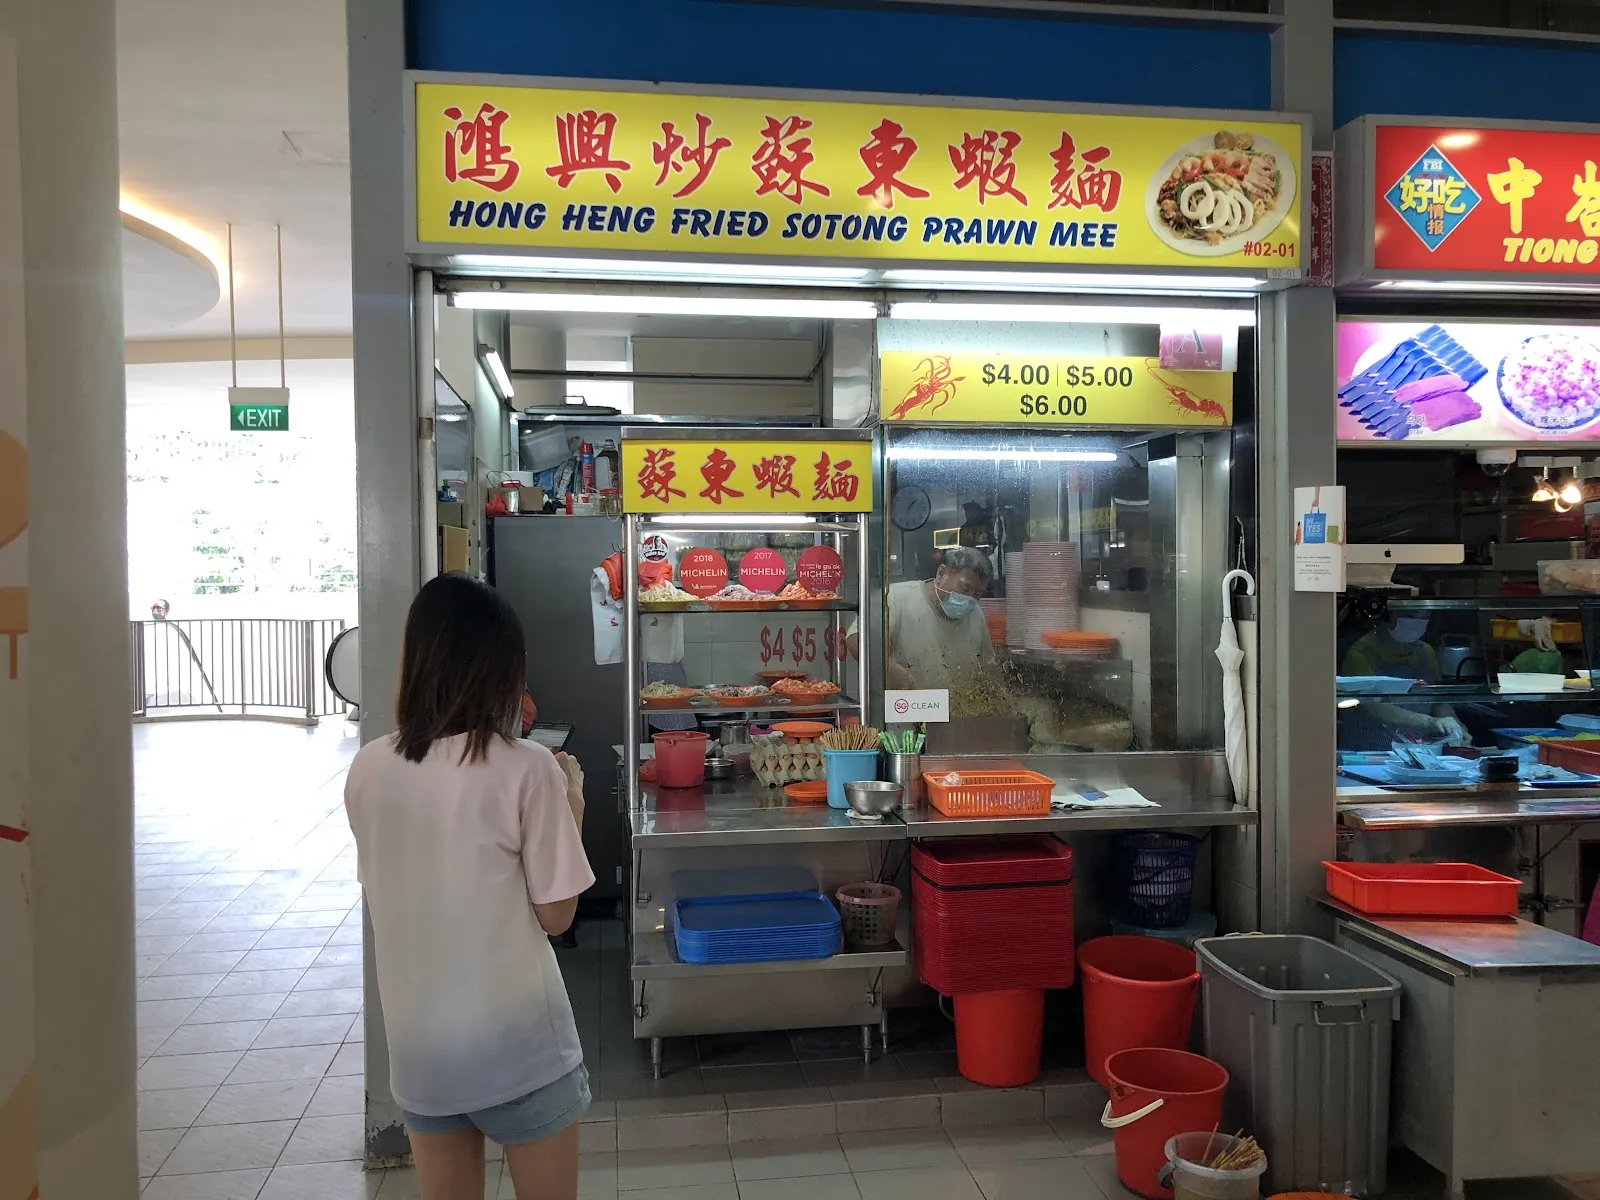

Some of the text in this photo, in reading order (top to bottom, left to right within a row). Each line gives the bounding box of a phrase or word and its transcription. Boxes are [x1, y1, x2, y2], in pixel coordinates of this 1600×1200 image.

[1400, 174, 1467, 214] 好吃
[449, 200, 1118, 248] HONG HENG FRIED SOTONG PRAWN MEE
[1427, 202, 1445, 236] 情报
[1243, 241, 1295, 258] #02-01
[1503, 237, 1599, 264] TIONG
[1272, 268, 1297, 278] 02-01
[1174, 327, 1208, 354] A
[982, 363, 1134, 388] $4.00 $5.00
[1020, 394, 1087, 418] $6.00
[246, 409, 282, 428] EXIT
[693, 554, 714, 563] 2018
[754, 552, 773, 560] 2017
[680, 567, 728, 577] MICHELIN
[740, 567, 786, 576] MICHELIN
[810, 577, 831, 586] 2016
[760, 624, 849, 667] $4 $5 $6
[895, 702, 940, 711] SG CLEAN
